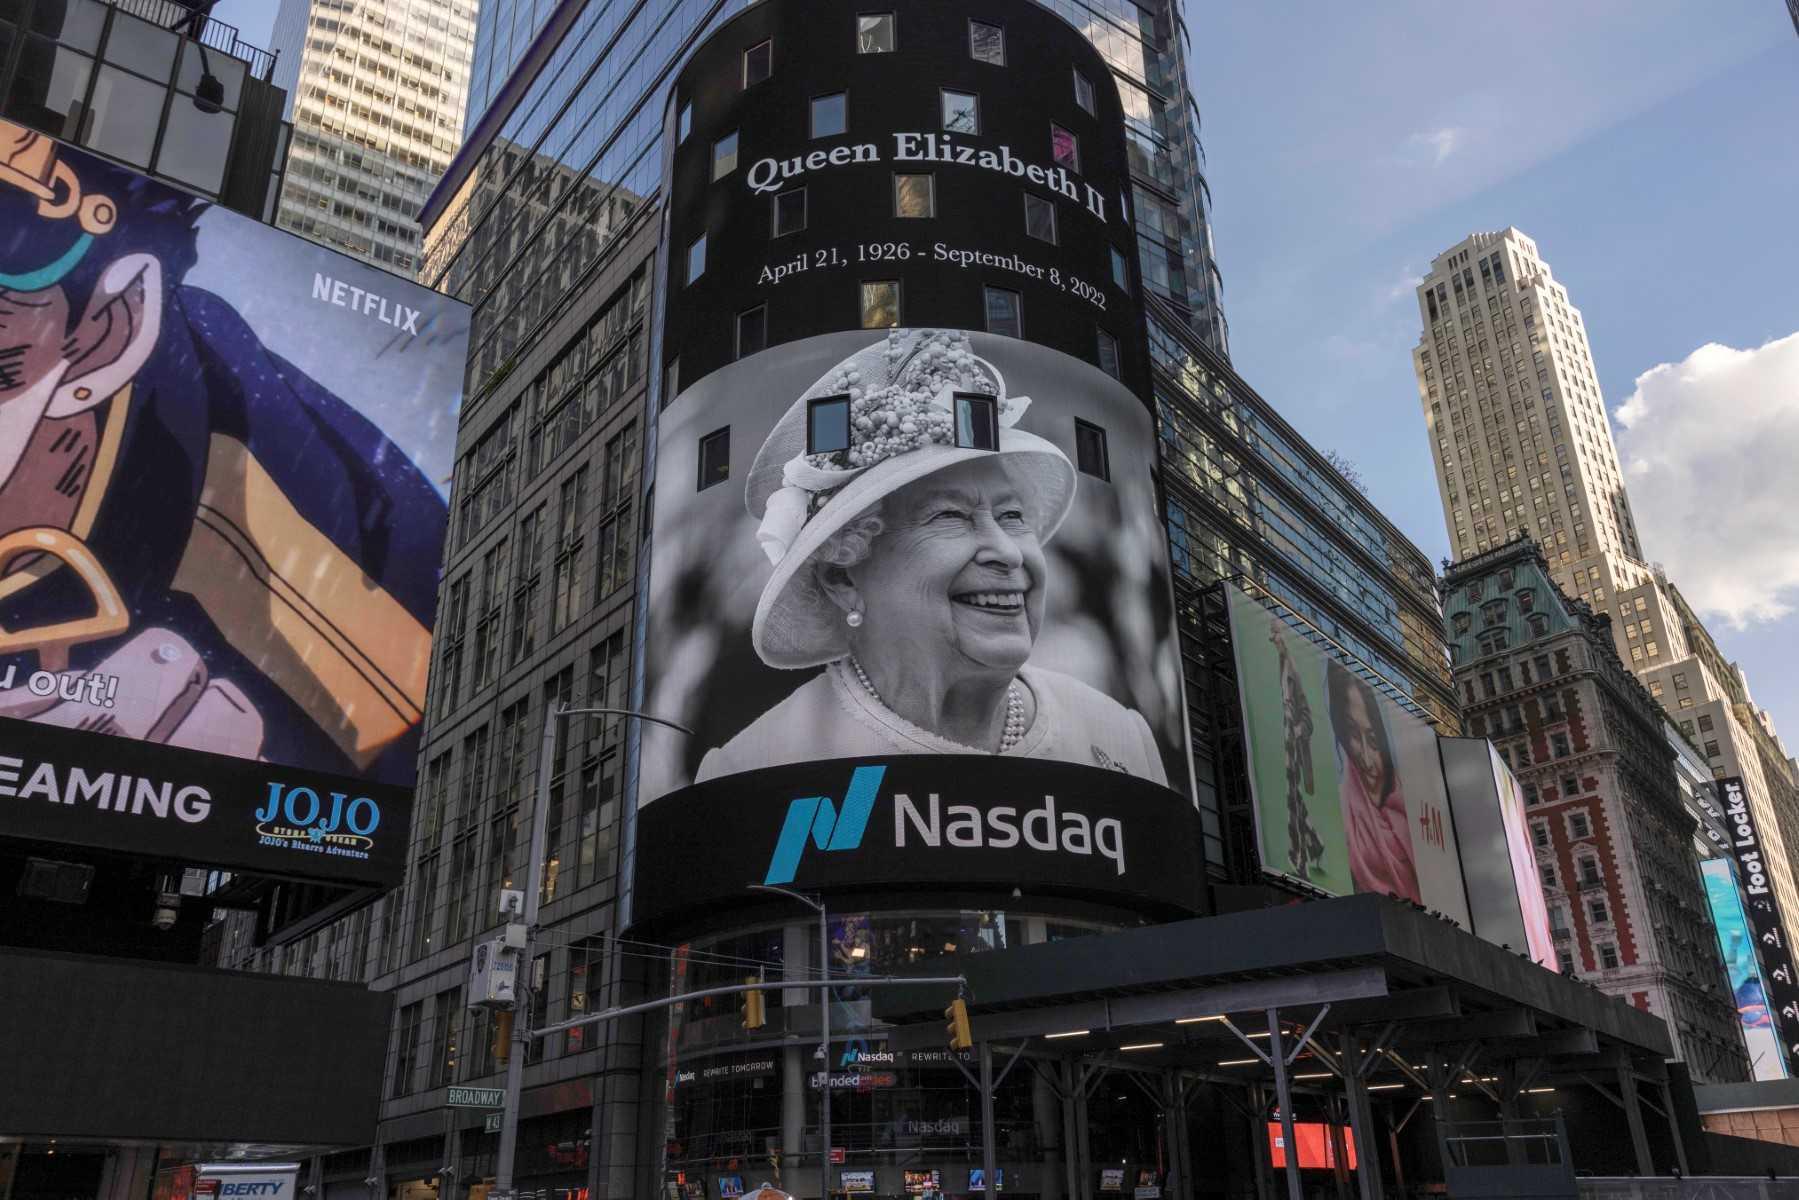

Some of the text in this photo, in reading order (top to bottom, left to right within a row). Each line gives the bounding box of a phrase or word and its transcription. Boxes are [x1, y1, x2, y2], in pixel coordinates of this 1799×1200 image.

[746, 132, 1107, 224] Queen Elizabeth II
[757, 253, 809, 285] April
[815, 248, 848, 267] 21,
[857, 242, 911, 262] 1926
[934, 242, 1045, 280] September
[1049, 267, 1067, 292] 8,
[1070, 276, 1107, 312] 2022
[312, 272, 421, 336] NETFLIX
[28, 670, 120, 708] out!
[0, 755, 213, 823] EAMING
[255, 782, 380, 835] JOJO
[893, 792, 1126, 876] Nasdaq
[1740, 851, 1769, 895] Foot
[858, 1051, 894, 1064] Nasdaq
[448, 1089, 500, 1105] BROADWAY
[219, 1182, 284, 1197] IBERTY
